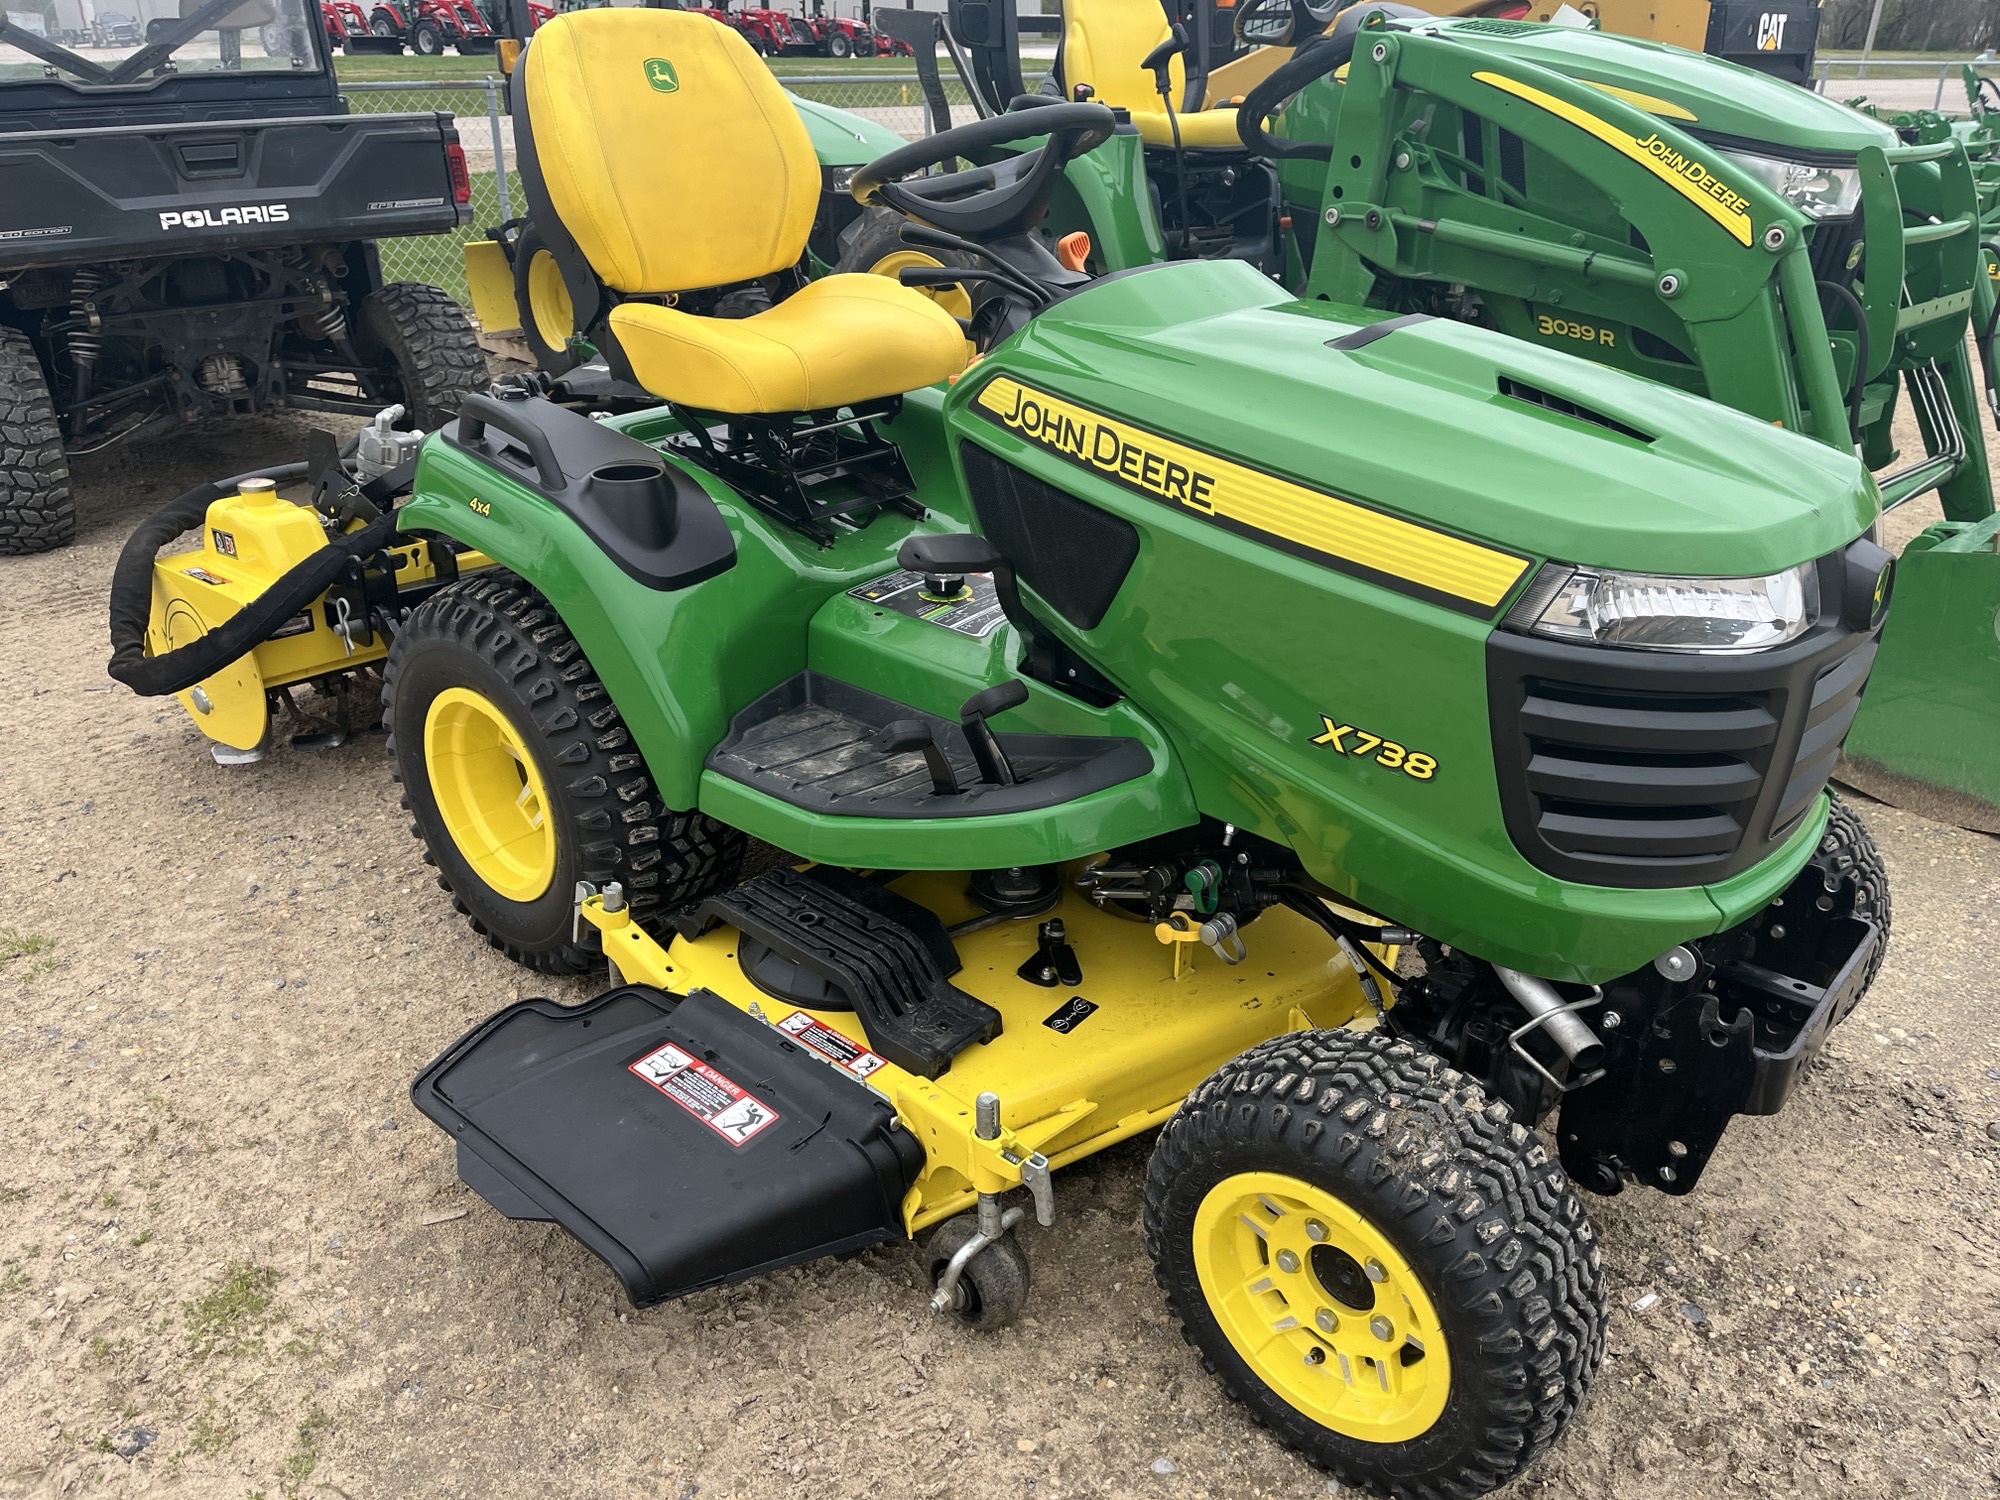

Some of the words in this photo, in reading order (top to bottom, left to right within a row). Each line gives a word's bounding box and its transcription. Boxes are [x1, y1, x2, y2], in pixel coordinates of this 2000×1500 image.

[1757, 12, 1788, 51] CAT
[1635, 133, 1690, 173] JOHN
[1682, 162, 1751, 214] DEERE
[159, 203, 290, 230] POLARIS
[1538, 315, 1596, 341] 3039
[1599, 328, 1615, 347] R
[1004, 388, 1087, 455] JOHN
[1091, 423, 1216, 511] DEERE
[469, 497, 491, 517] 4x4
[1310, 715, 1438, 780] X738
[703, 1070, 741, 1096] DANGER
